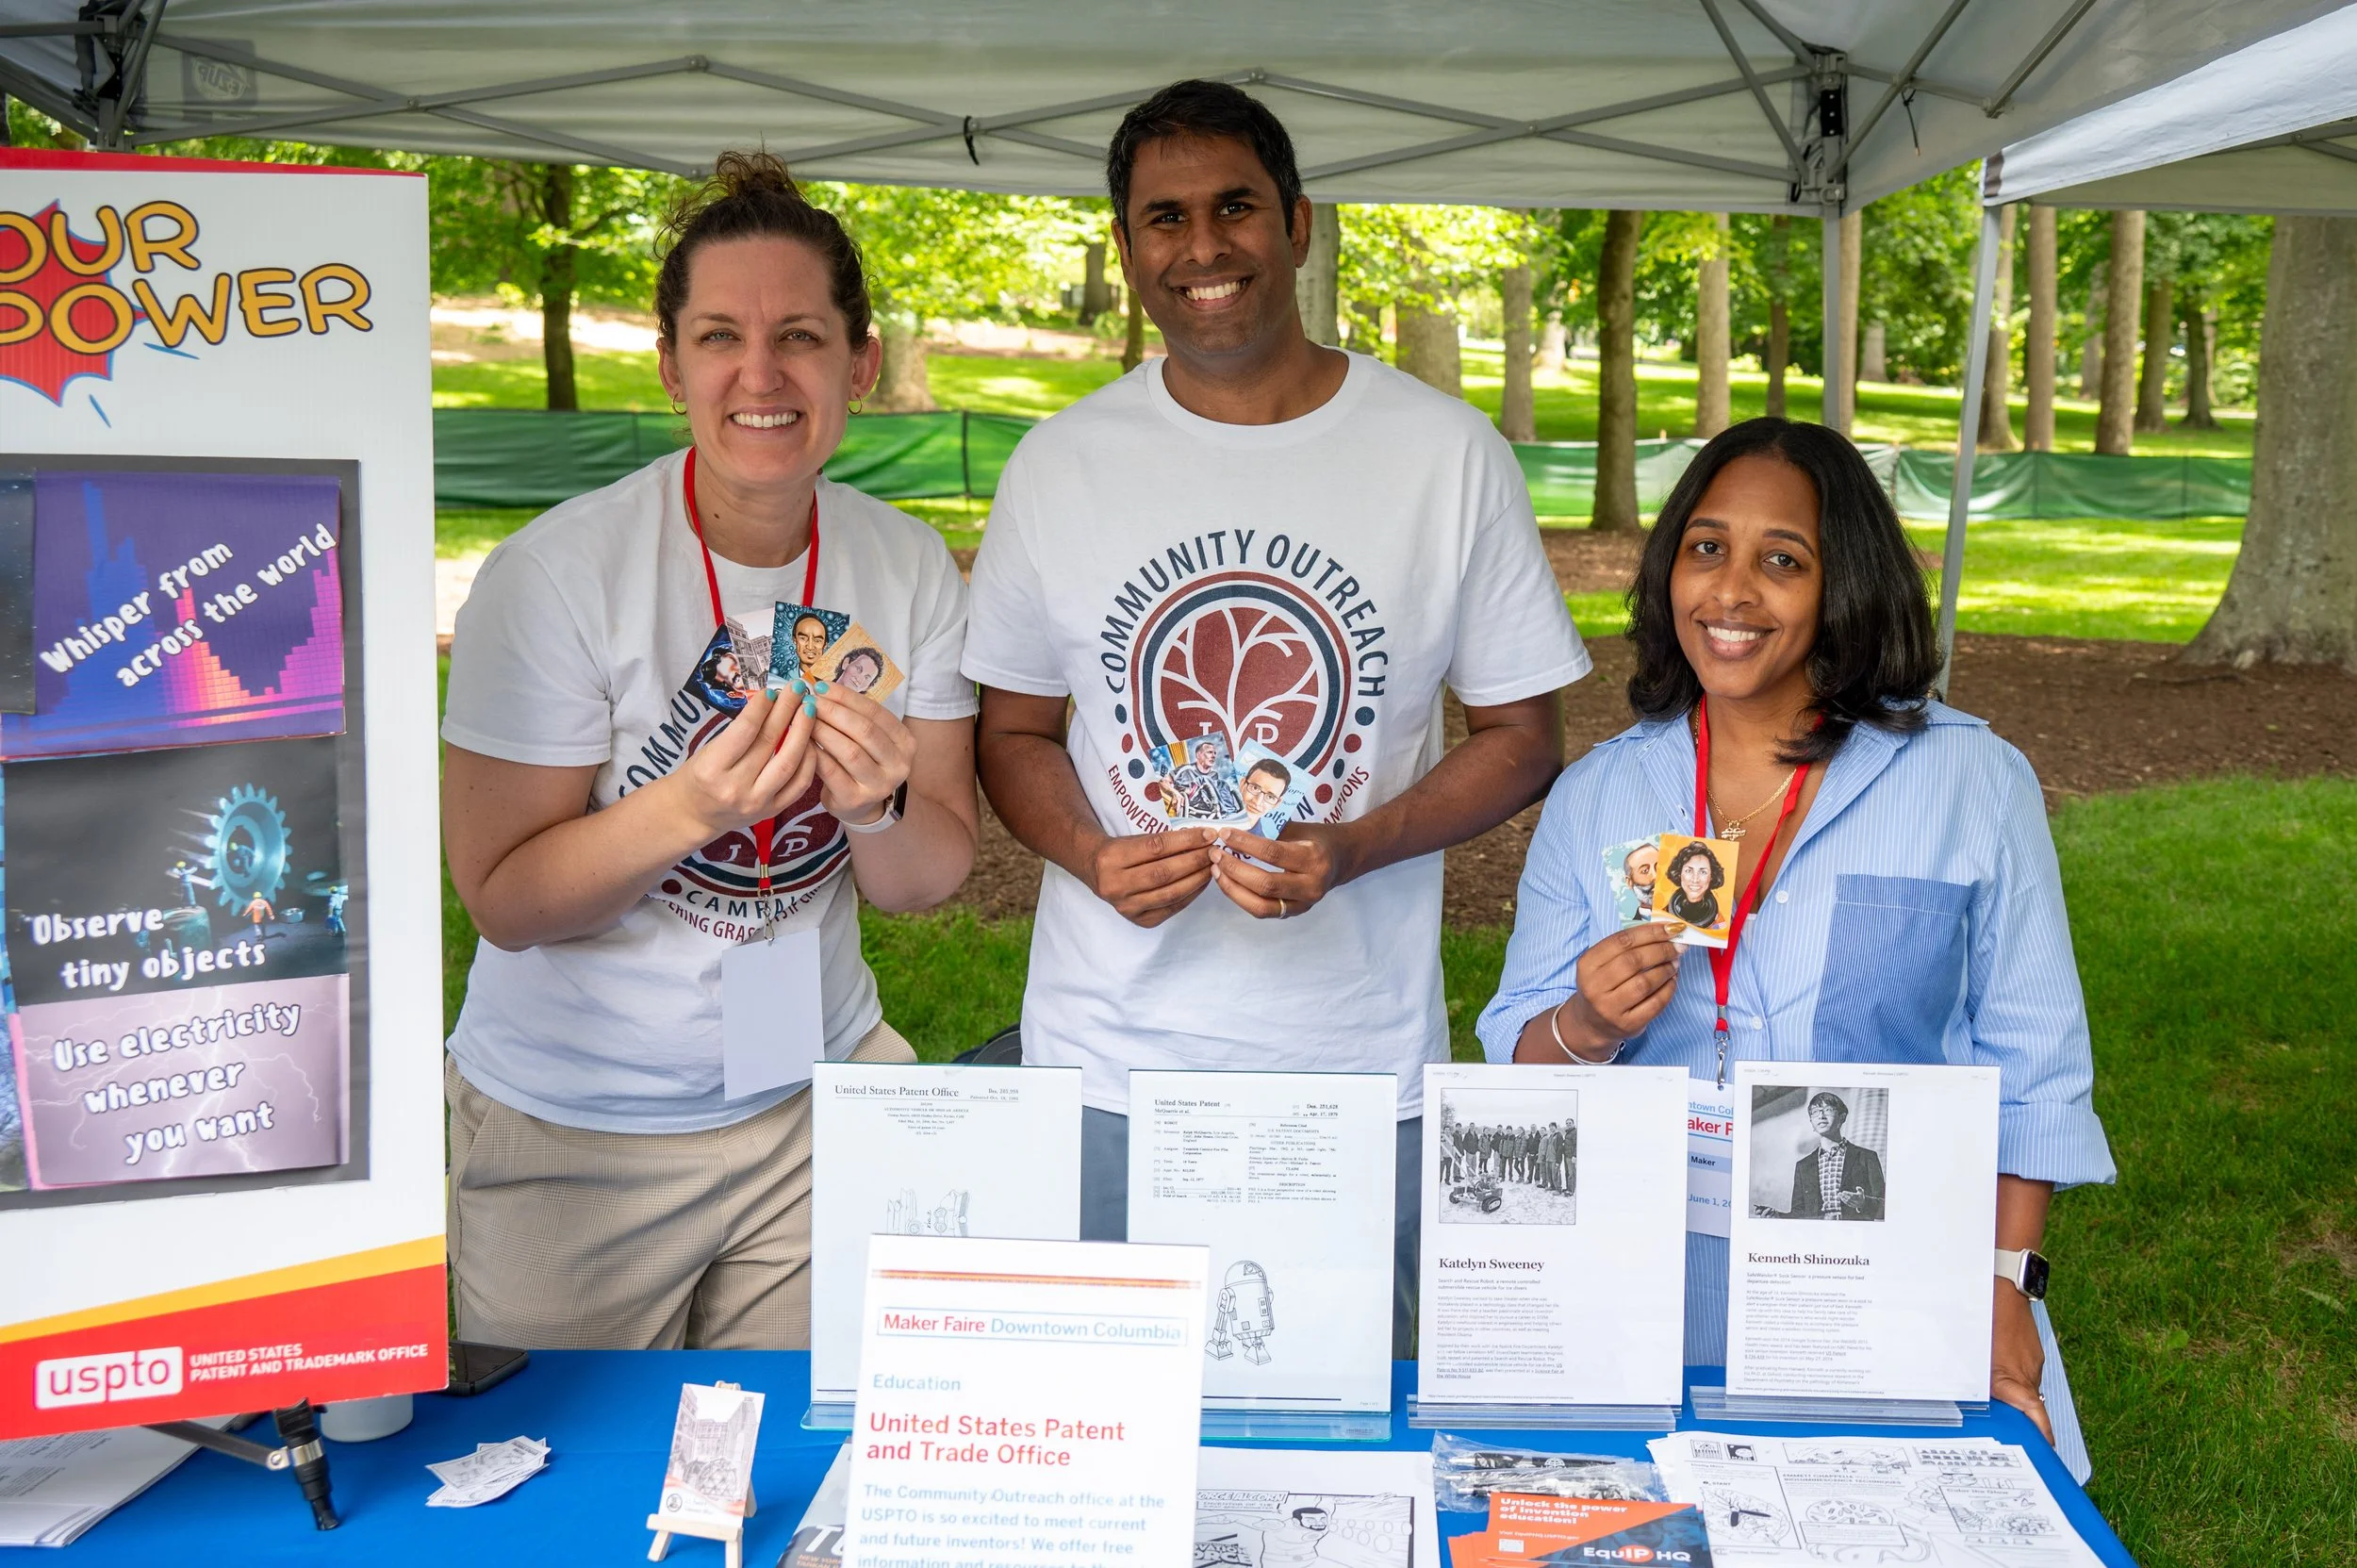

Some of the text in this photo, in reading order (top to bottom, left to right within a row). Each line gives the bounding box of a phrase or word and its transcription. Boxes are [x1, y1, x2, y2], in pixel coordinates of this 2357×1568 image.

[41, 542, 234, 674] Whisper from
[116, 523, 338, 687] across the world
[1100, 529, 1389, 697] COMMUNITY OUTREACH
[32, 908, 165, 945] Observe
[60, 941, 266, 992] tiny objects
[54, 1003, 301, 1072] Use electricity
[84, 1062, 245, 1115] whenever
[834, 1084, 959, 1098] United States Patent Office
[124, 1101, 274, 1164] you want
[1688, 1117, 1721, 1133] aker
[1690, 1156, 1715, 1166] Maker
[1689, 1194, 1709, 1205] June
[1712, 1198, 1720, 1207] 1,
[1439, 1258, 1544, 1271] Katelyn Sweeney
[1748, 1252, 1870, 1266] Kenneth Shinozuka
[883, 1313, 1181, 1340] Maker Faire Downtown Columbia
[190, 1344, 303, 1367] UNITED STATES
[190, 1344, 428, 1382] PATENT AND TRADEMARK OFFICE
[50, 1351, 169, 1401] uspto
[873, 1374, 962, 1391] Education
[870, 1412, 1125, 1441] United States Patent
[866, 1442, 1071, 1466] and Trade Office
[864, 1484, 1164, 1509] The Community Outreach office at the
[1500, 1497, 1628, 1513] Unlock the power
[862, 1508, 1146, 1531] USPTO is so excited to meet current
[1500, 1505, 1589, 1518] of invention
[1500, 1512, 1577, 1525] education!
[860, 1531, 888, 1545] and
[894, 1532, 941, 1547] future
[947, 1535, 1025, 1550] inventors!
[1031, 1537, 1054, 1551] We
[1059, 1538, 1097, 1553] offer
[1102, 1540, 1133, 1555] free
[1583, 1547, 1691, 1562] EquIP HQ
[858, 1555, 950, 1568] information
